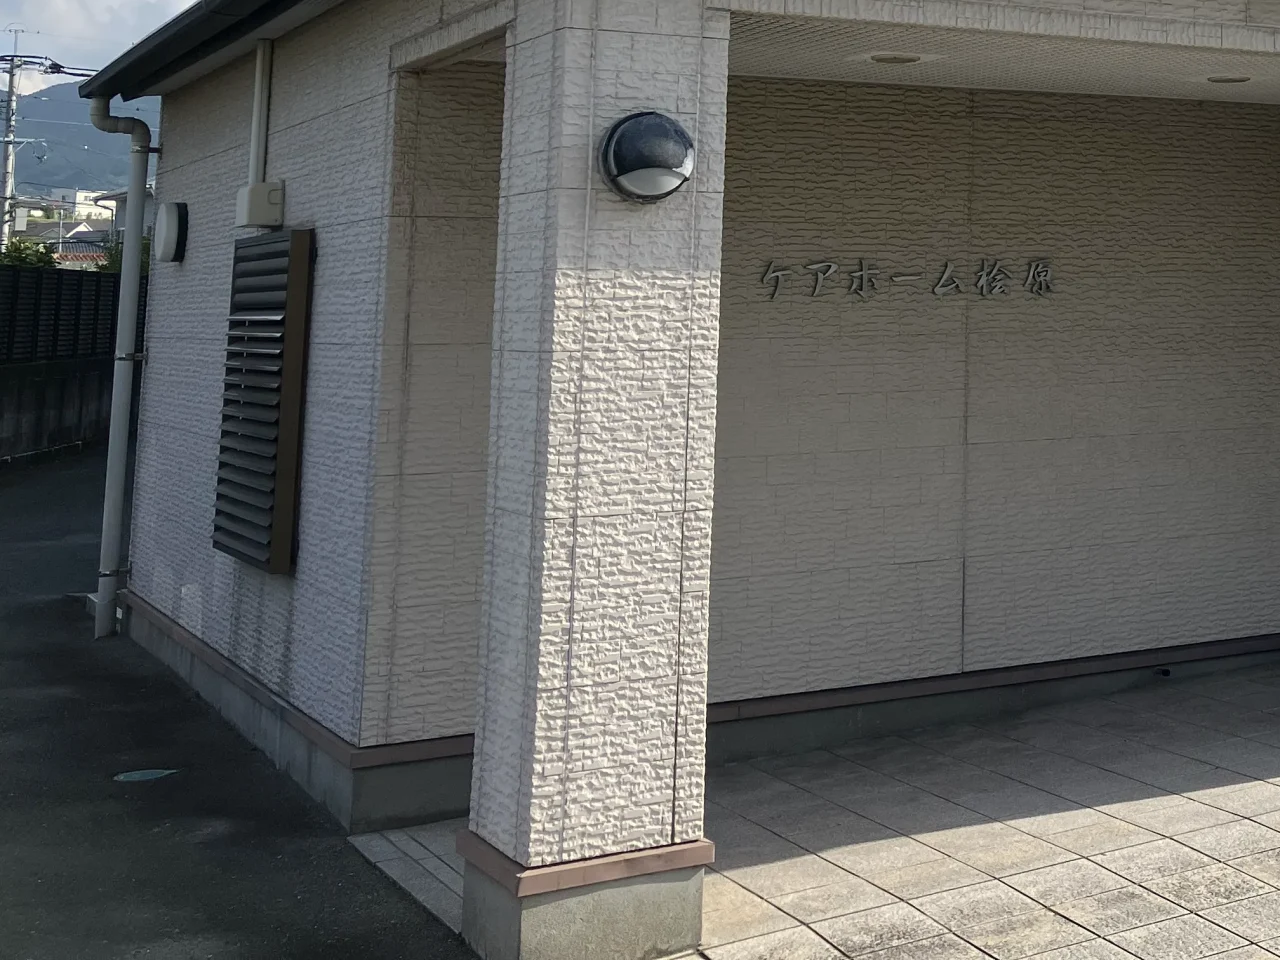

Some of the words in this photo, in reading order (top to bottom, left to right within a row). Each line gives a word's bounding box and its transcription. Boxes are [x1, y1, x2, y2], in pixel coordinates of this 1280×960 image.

[761, 259, 1056, 301] ケアホーム桧原
